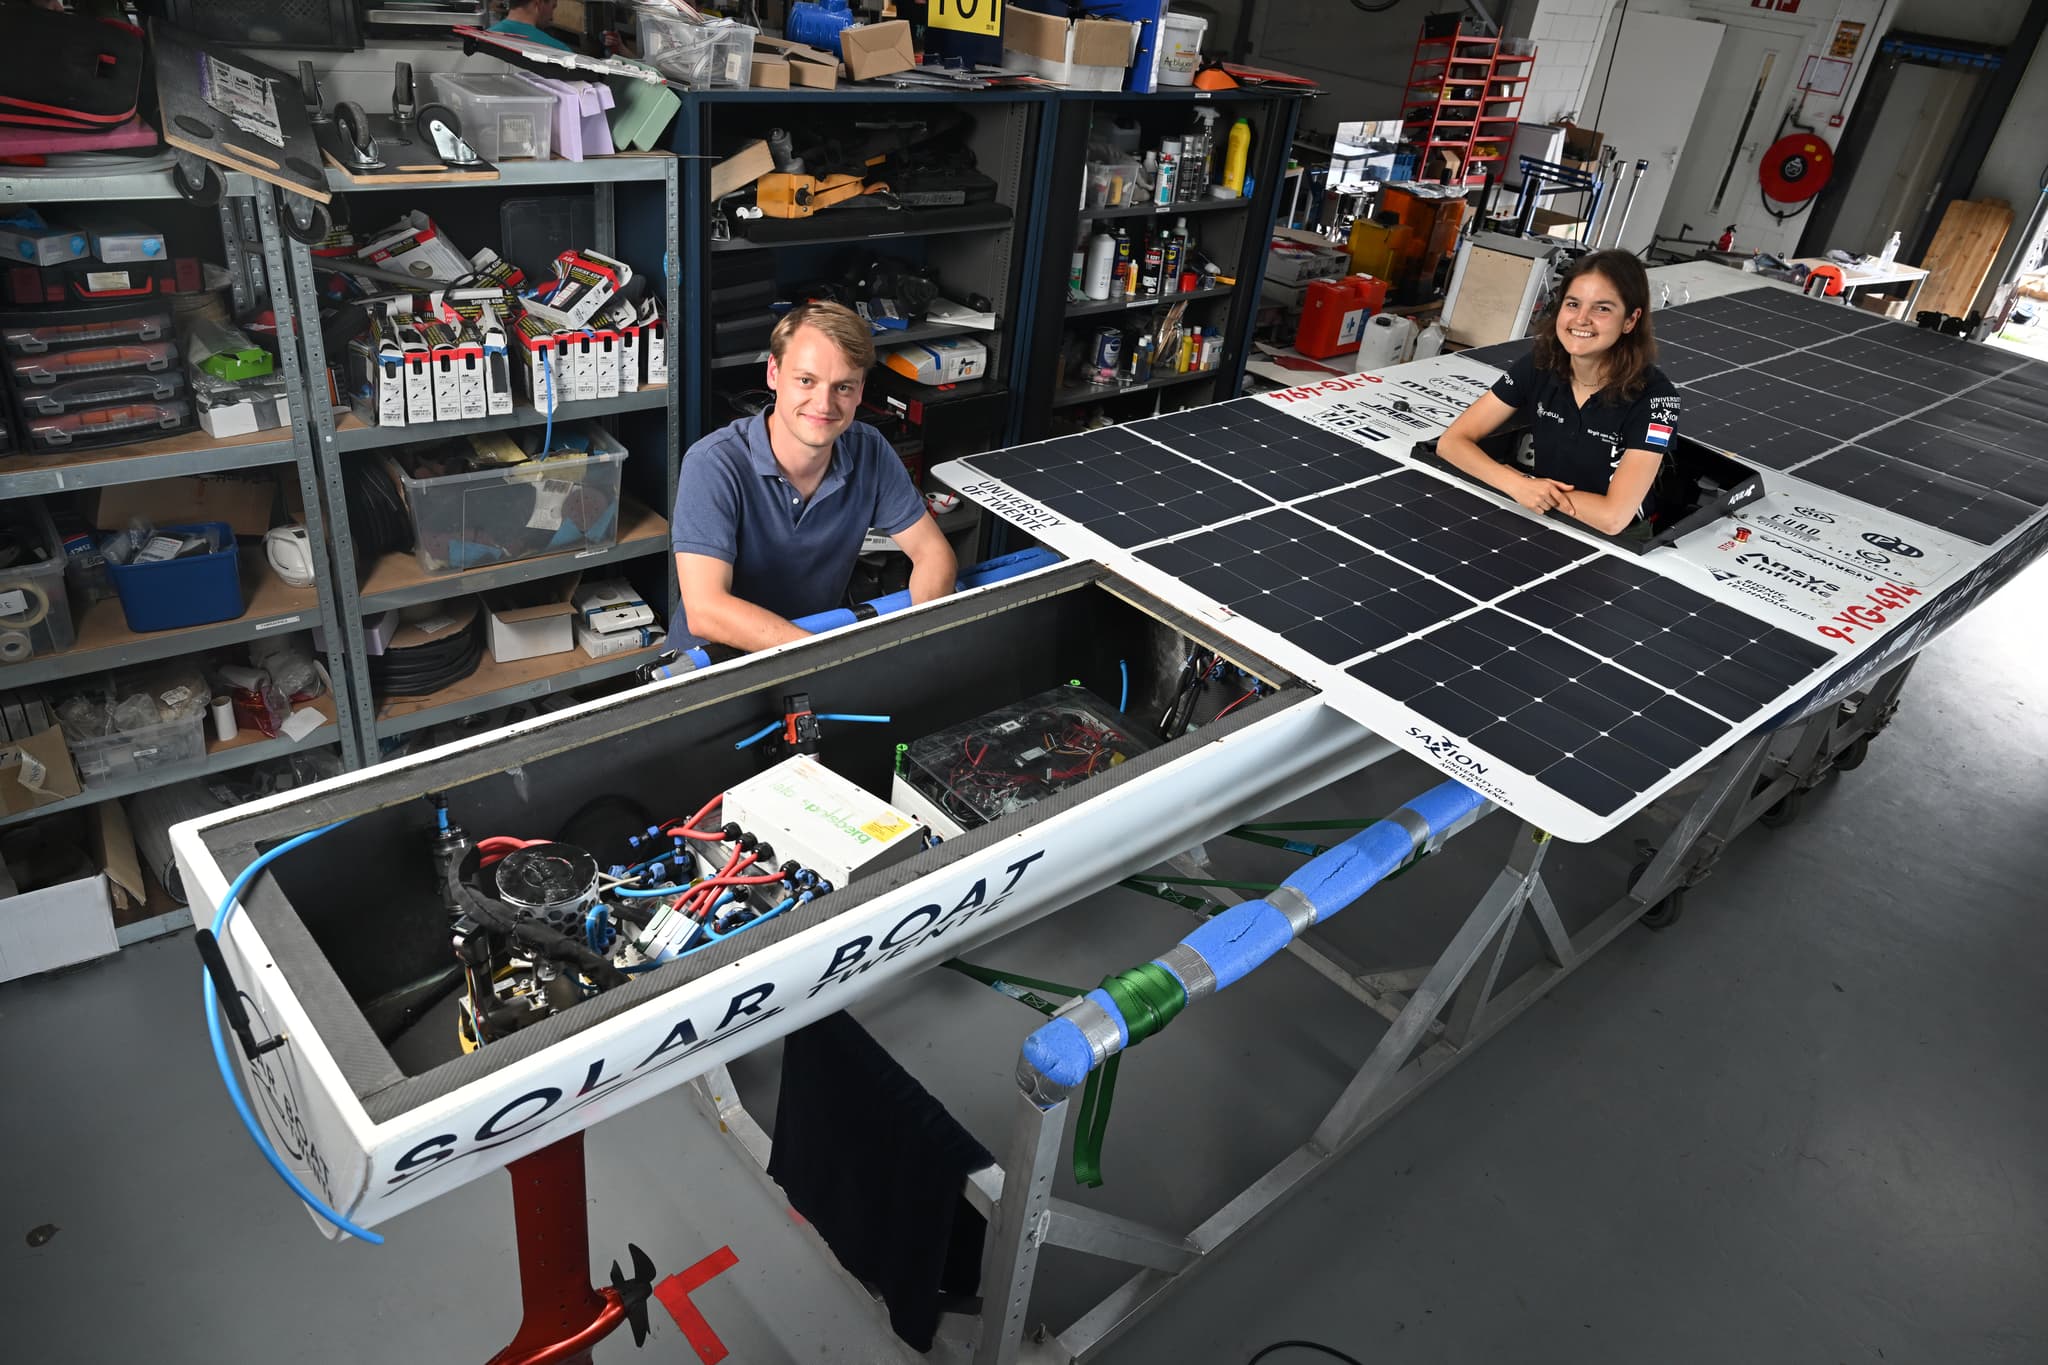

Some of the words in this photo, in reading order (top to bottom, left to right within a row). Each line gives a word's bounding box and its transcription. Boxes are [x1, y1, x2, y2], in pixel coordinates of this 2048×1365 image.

[961, 485, 989, 497] OF
[982, 496, 1047, 532] TWENTE
[978, 480, 1067, 527] UNIVERSITY
[1735, 580, 1789, 603] SURFACE
[1740, 552, 1841, 592] Ansys
[1744, 579, 1788, 598] BIONIC
[1752, 563, 1833, 599] infinite
[1726, 581, 1817, 621] TECHNOLOGIES
[1817, 581, 1922, 645] 9-YG-494
[1405, 727, 1489, 775] SAXION
[1438, 762, 1474, 783] APPLIED
[1475, 782, 1515, 807] SCIENCES
[1444, 759, 1494, 787] UNIVERSITY
[1493, 786, 1508, 796] OF
[818, 849, 1046, 983] BOAT
[807, 891, 1015, 999] TWENTE
[387, 982, 776, 1184] SOLAR
